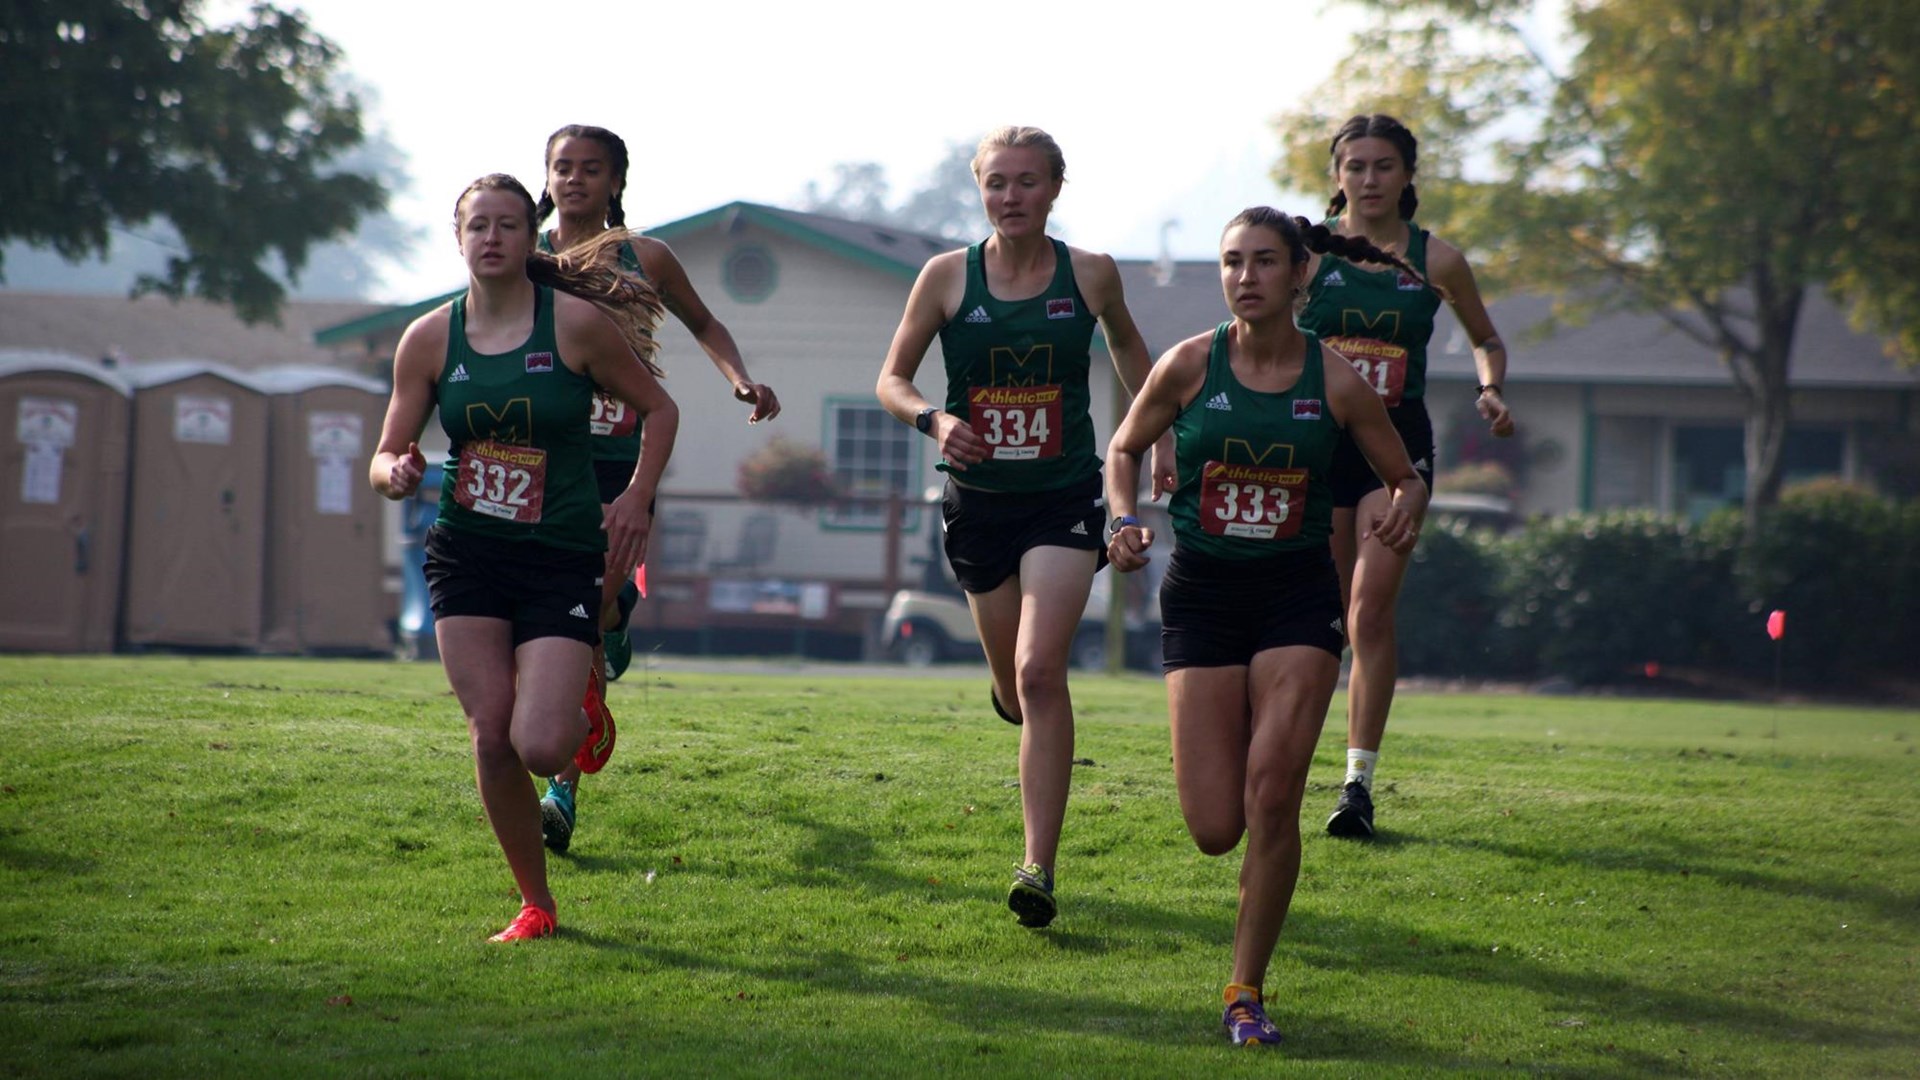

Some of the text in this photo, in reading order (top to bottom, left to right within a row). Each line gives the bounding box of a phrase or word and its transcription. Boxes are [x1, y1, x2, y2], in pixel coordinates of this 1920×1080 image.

[1205, 402, 1232, 411] adidas
[983, 408, 1050, 446] 334
[467, 459, 531, 506] 332
[1215, 483, 1290, 524] 333
